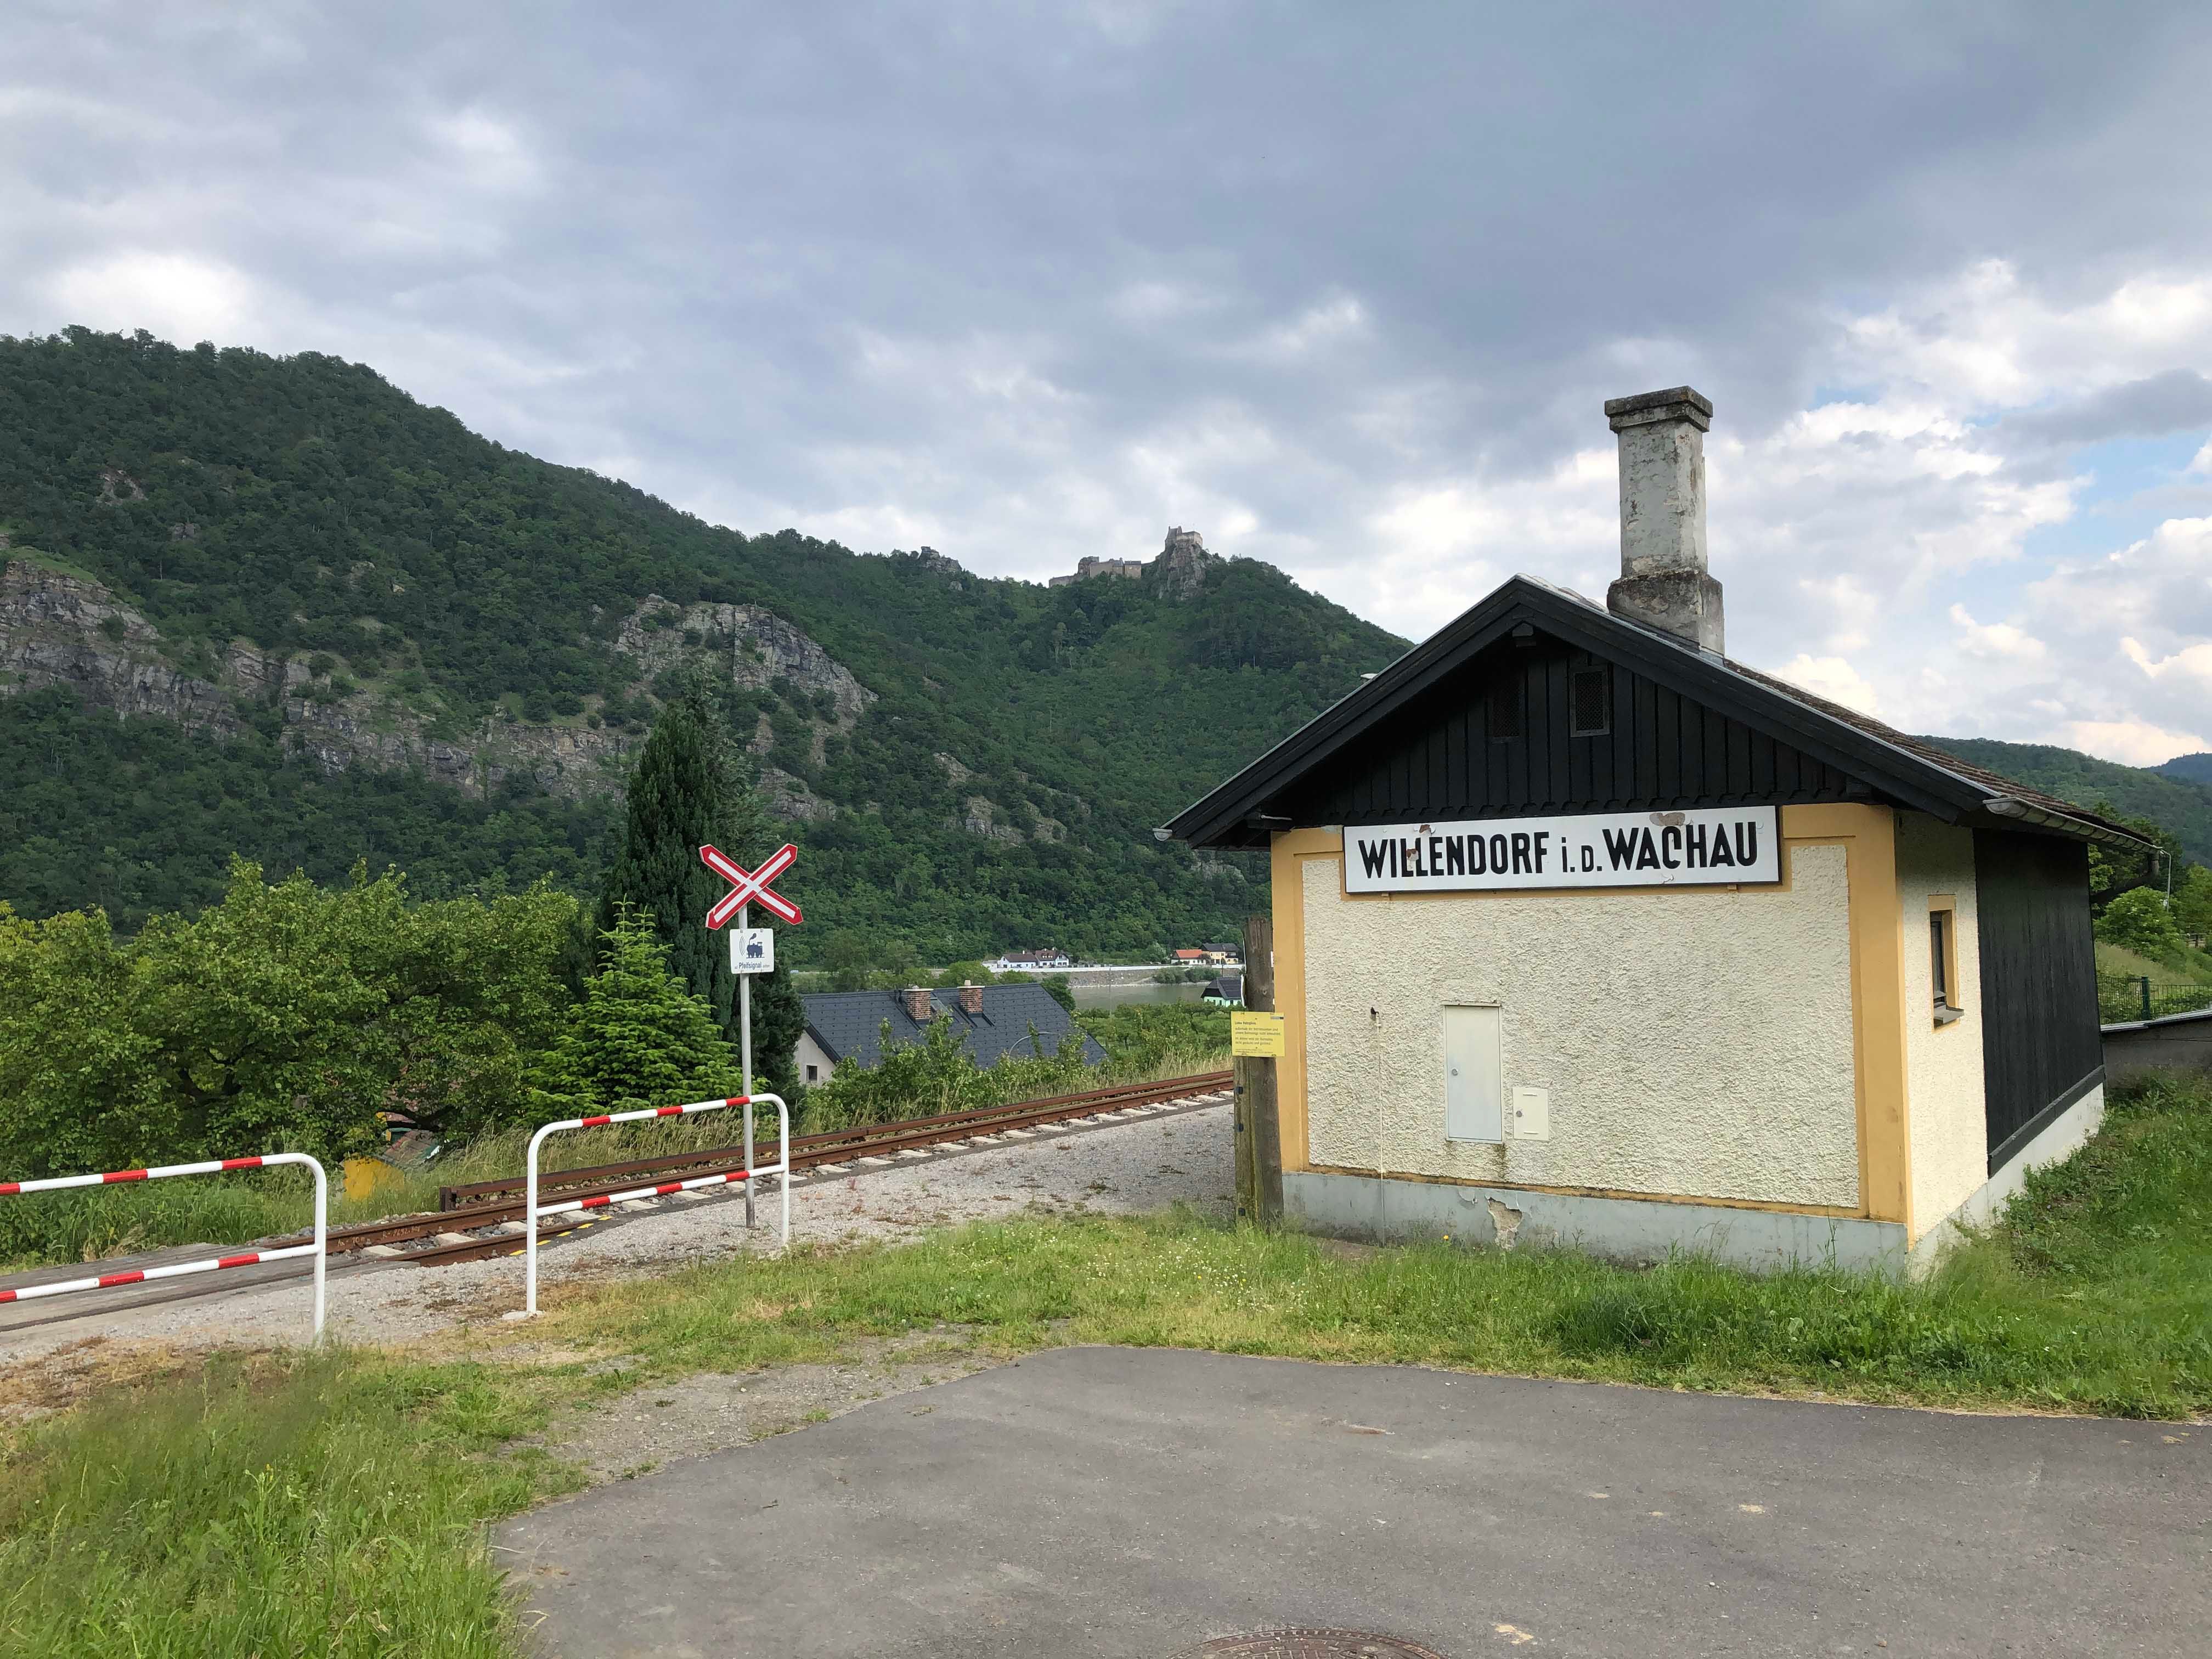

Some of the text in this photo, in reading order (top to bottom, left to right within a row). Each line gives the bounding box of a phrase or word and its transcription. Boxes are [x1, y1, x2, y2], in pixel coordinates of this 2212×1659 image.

[1358, 831, 1549, 878] WILLENDORF
[1602, 821, 1758, 871] WACHAU
[738, 961, 762, 970] Pfeifsignal
